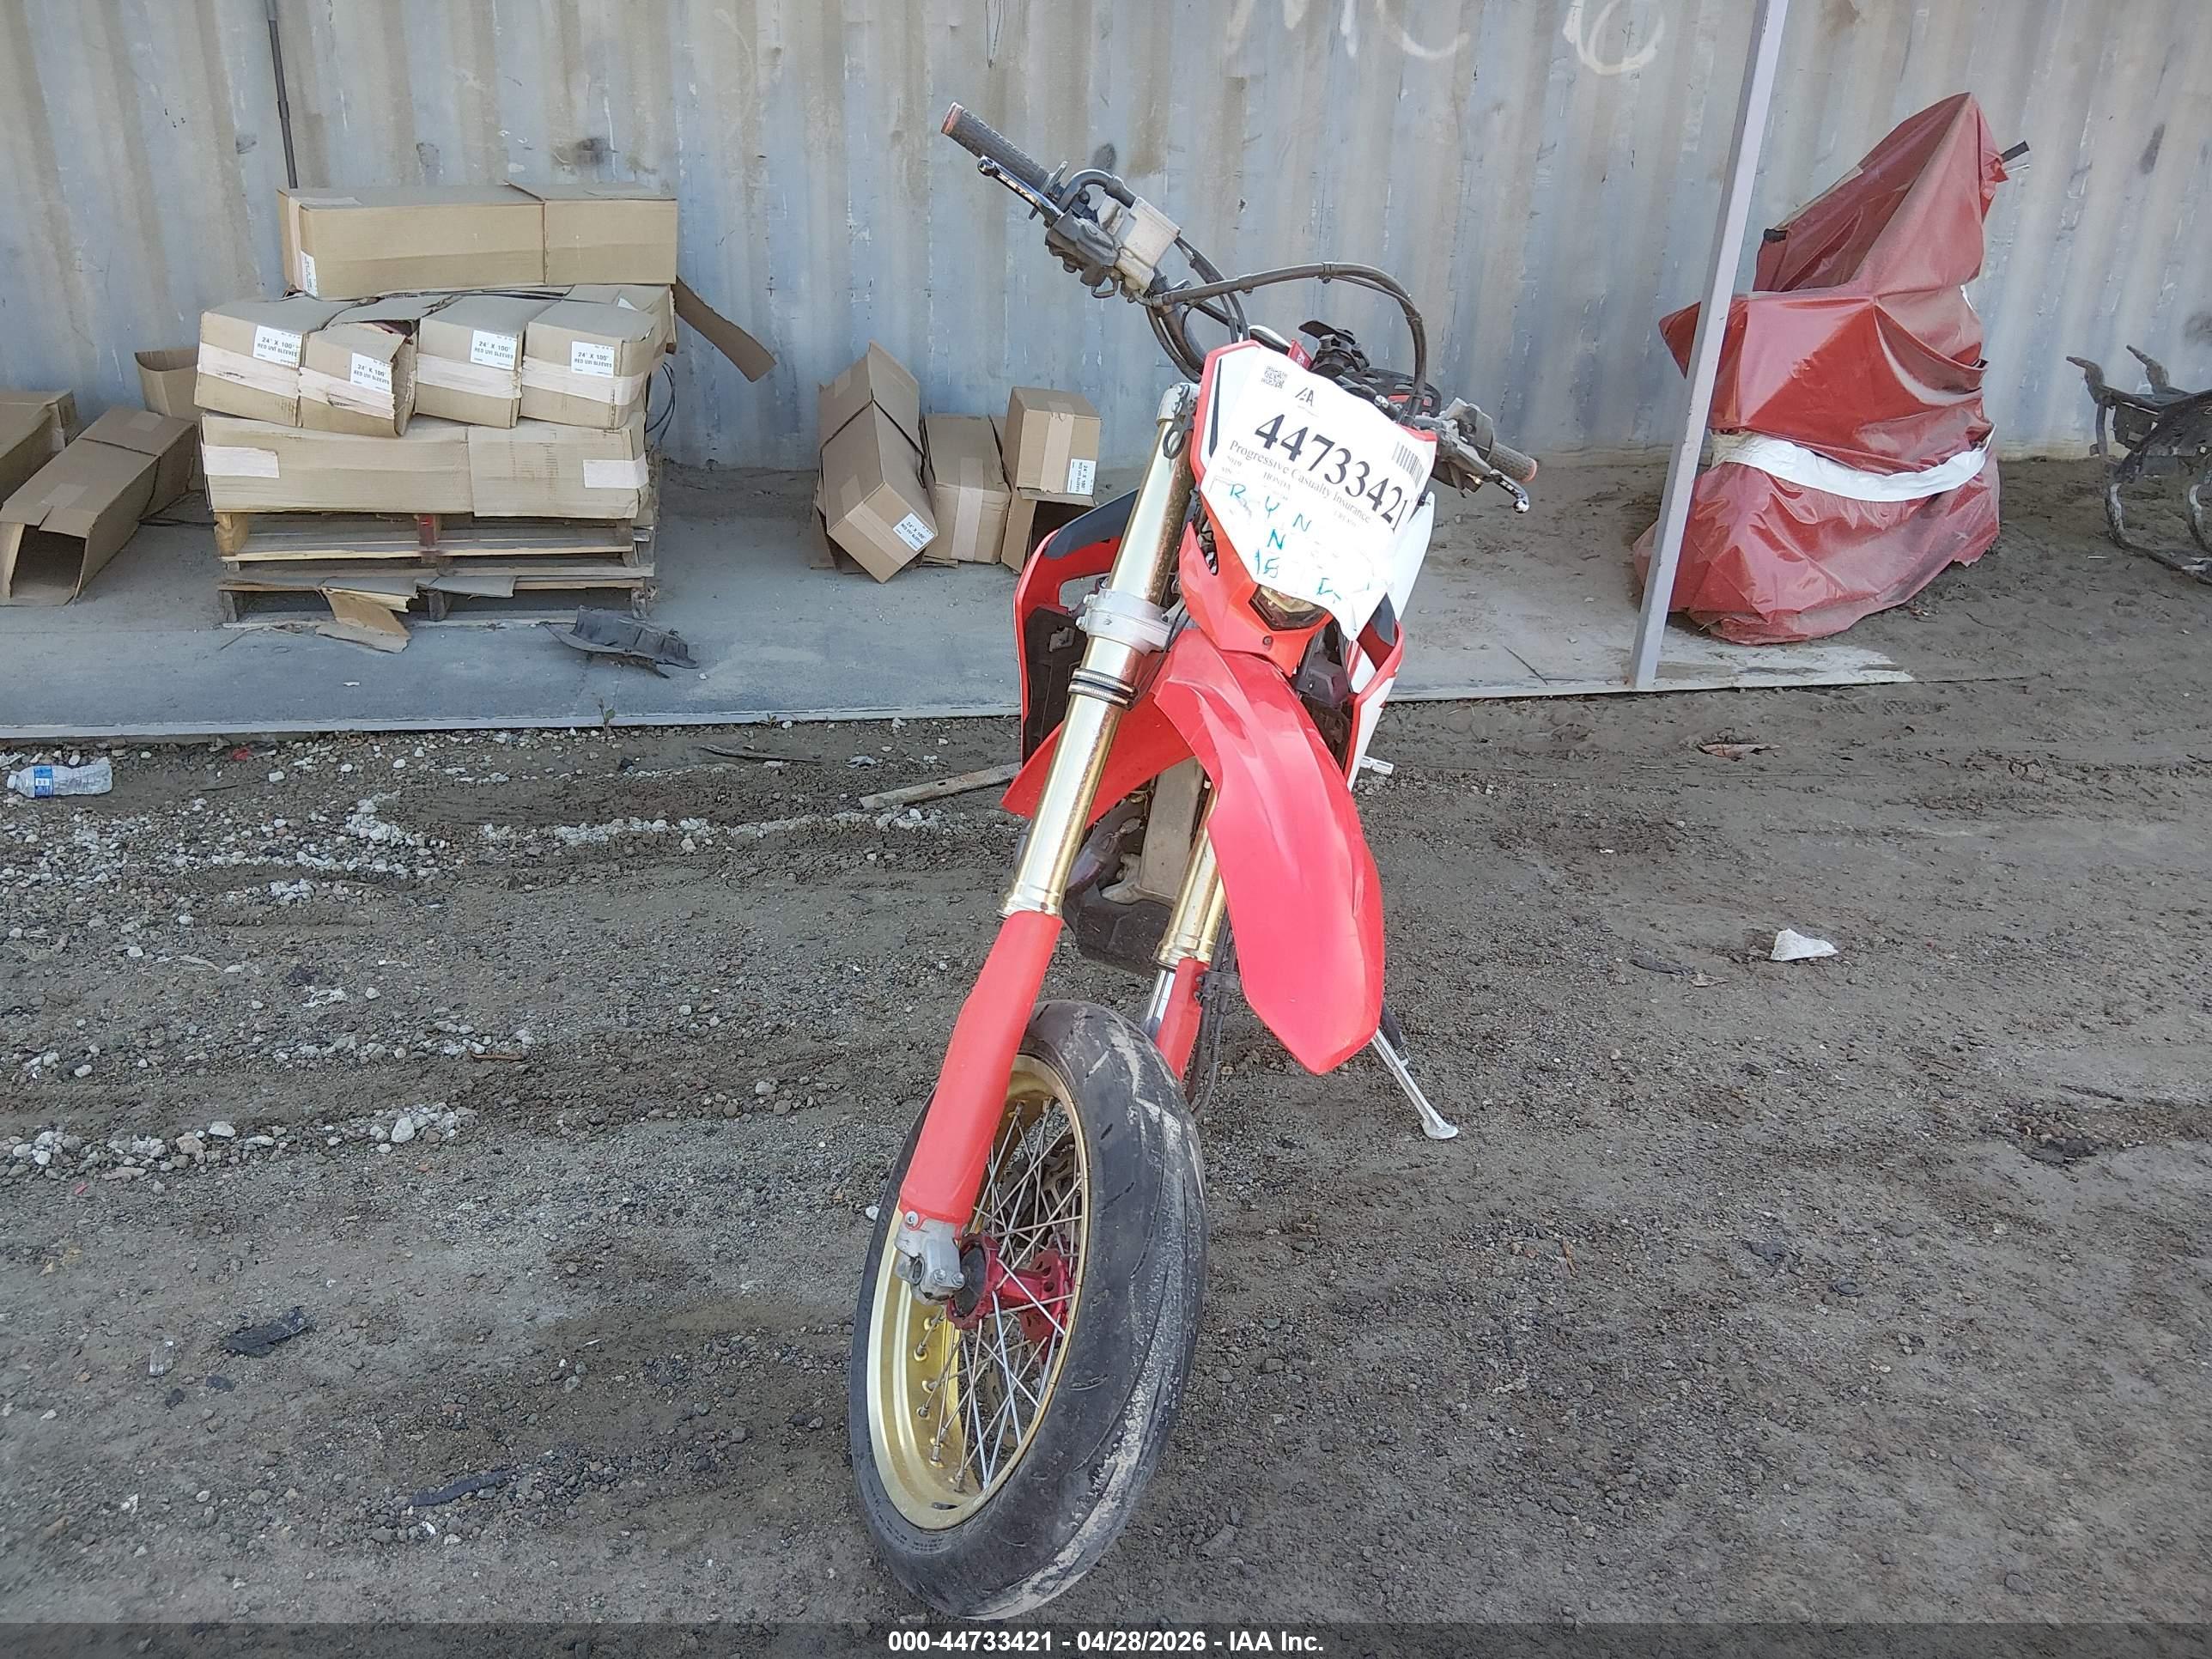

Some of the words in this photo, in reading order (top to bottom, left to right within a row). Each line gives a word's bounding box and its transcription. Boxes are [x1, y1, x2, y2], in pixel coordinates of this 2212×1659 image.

[1230, 440, 1290, 474] Progressive
[1291, 468, 1331, 499] Casualty
[1333, 491, 1372, 524] Insurance
[1255, 414, 1408, 534] 44733421
[1230, 483, 1246, 499] R
[1292, 513, 1312, 532] N
[1267, 528, 1286, 550] N
